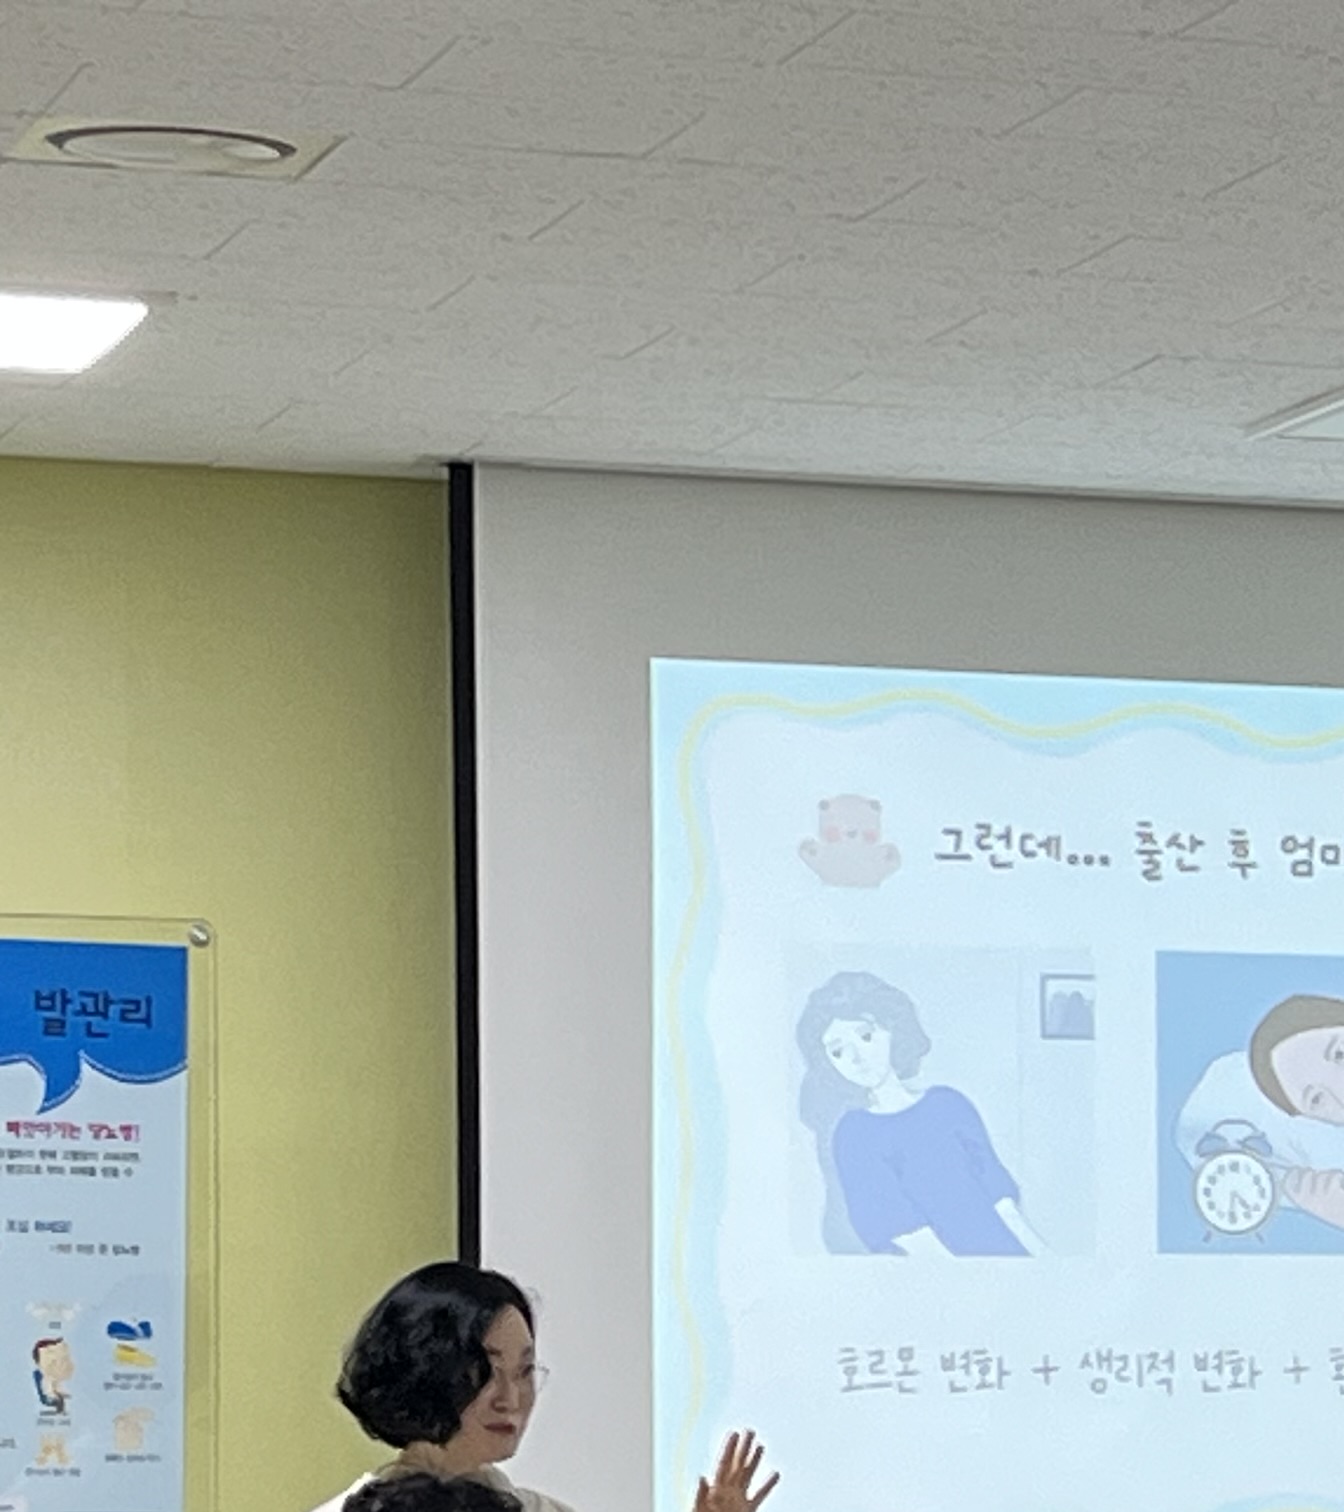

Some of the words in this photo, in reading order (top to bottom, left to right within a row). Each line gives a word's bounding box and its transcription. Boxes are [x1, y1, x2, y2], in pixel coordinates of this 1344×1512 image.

[933, 821, 1112, 870] 그런데...
[1133, 819, 1206, 882] 출산
[1227, 828, 1259, 881] 후
[33, 987, 154, 1038] 발관리
[836, 1345, 922, 1395] 호르몬
[939, 1347, 1013, 1395] 변화
[1031, 1354, 1062, 1387] +
[1077, 1347, 1176, 1397] 생리적
[1192, 1347, 1264, 1395] 변화
[1282, 1355, 1311, 1385] +
